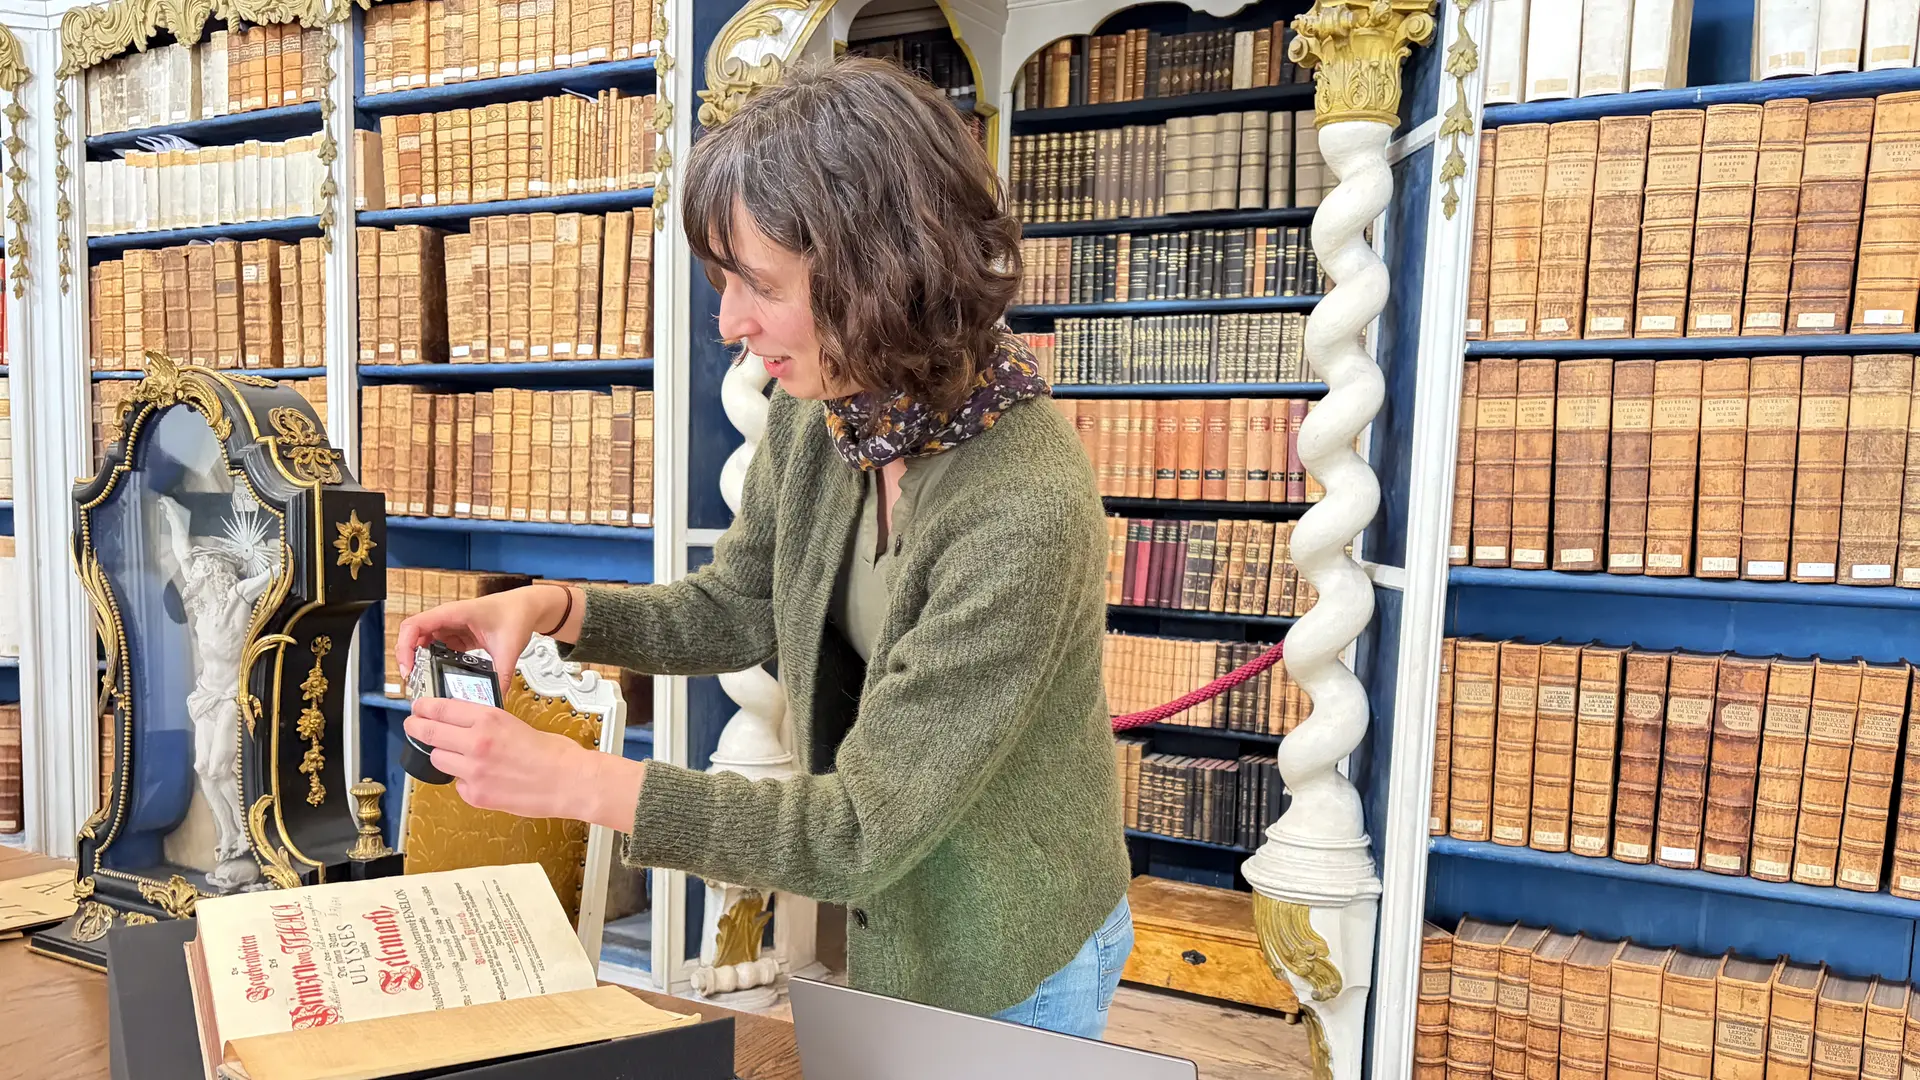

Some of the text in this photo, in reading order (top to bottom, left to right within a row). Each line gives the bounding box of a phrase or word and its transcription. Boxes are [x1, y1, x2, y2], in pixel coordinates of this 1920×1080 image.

[394, 889, 416, 923] FENELON
[238, 935, 274, 1003] Begebenheiten
[336, 924, 368, 985] ULYSSES
[337, 965, 348, 979] Der
[289, 963, 339, 1031] Prinzen
